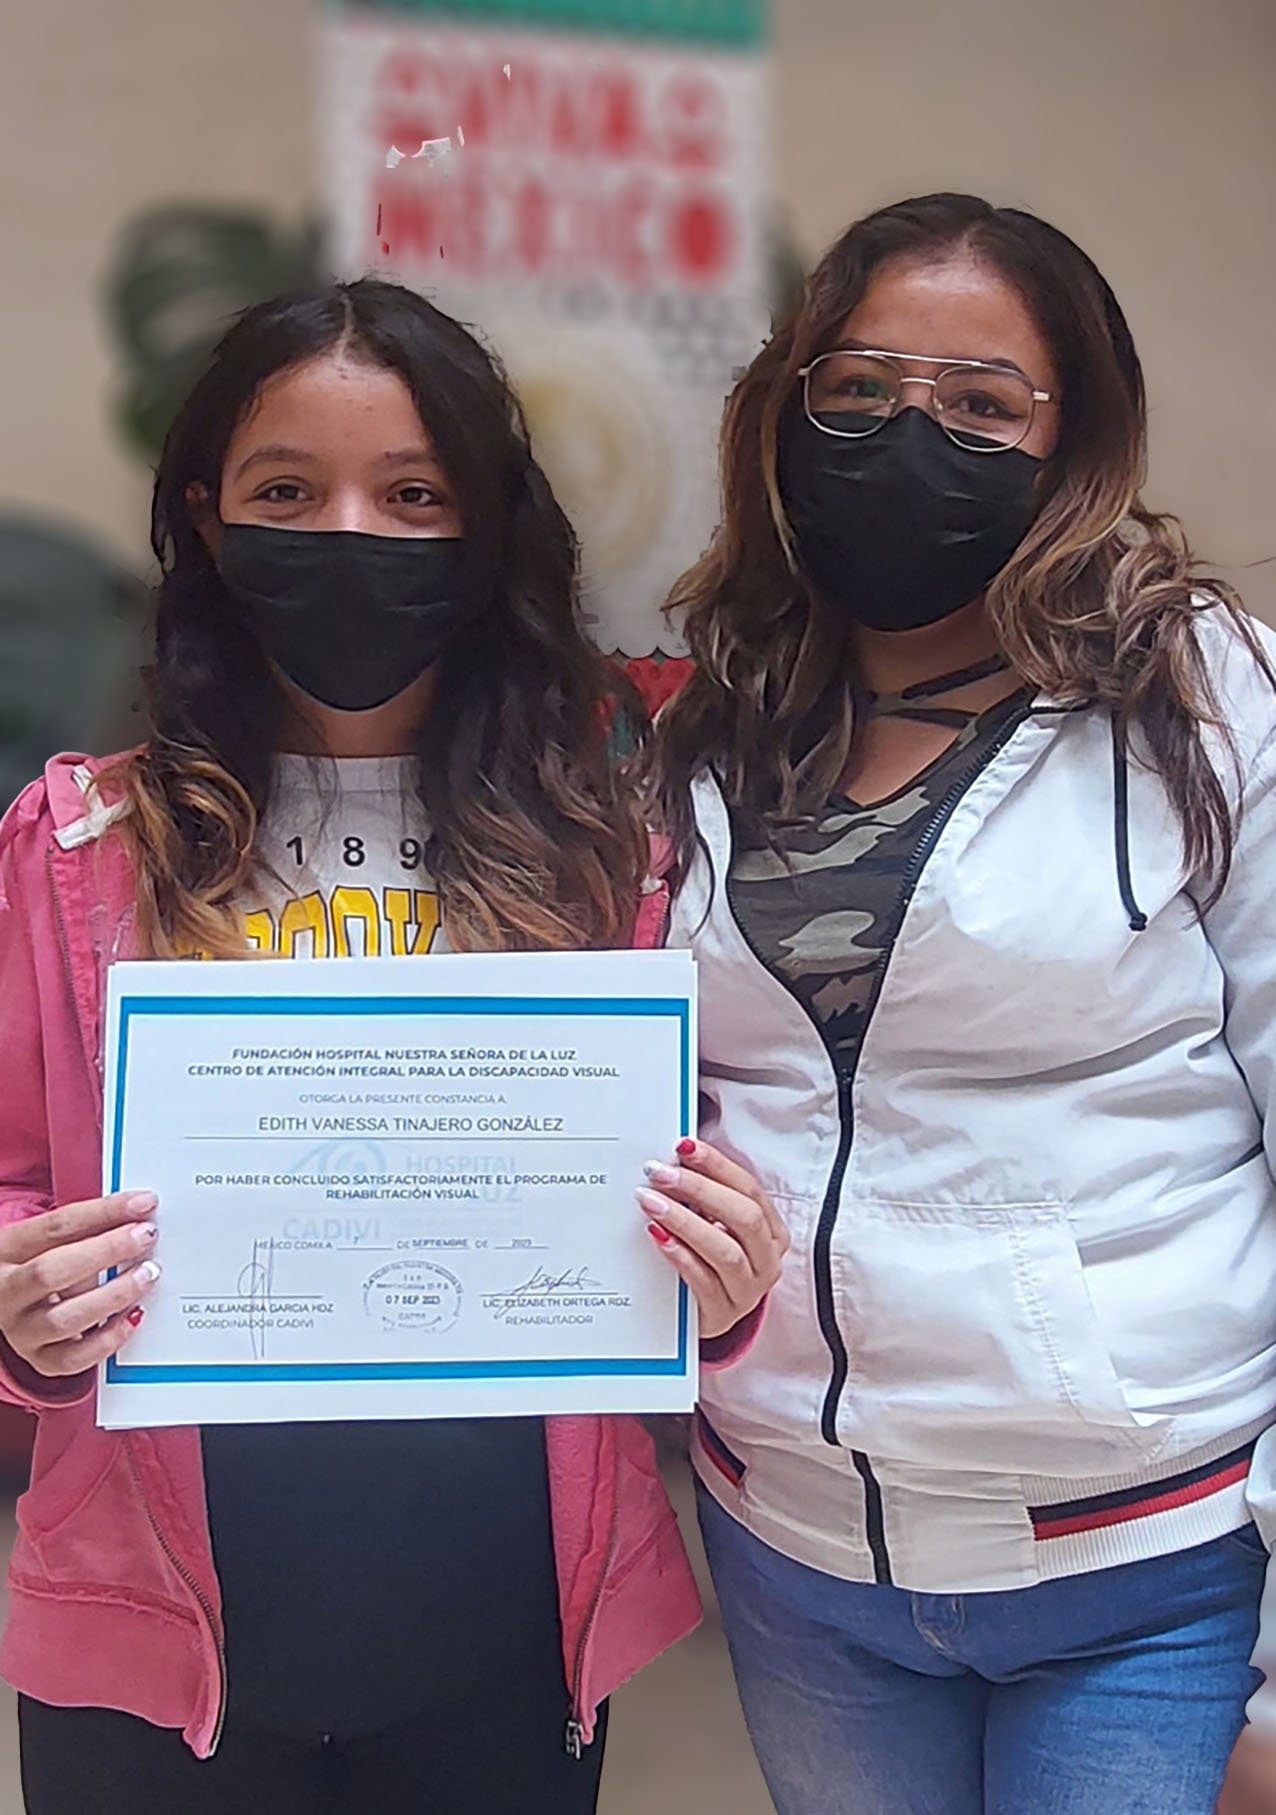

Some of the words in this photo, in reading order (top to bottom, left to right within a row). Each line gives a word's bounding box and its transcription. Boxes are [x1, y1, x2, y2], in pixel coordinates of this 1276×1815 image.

[233, 1048, 312, 1059] FUNDACIÓN
[316, 1050, 381, 1060] HOSPITAL
[385, 1050, 447, 1060] NUESTRA
[451, 1048, 505, 1060] SEÑORA
[509, 1050, 527, 1060] DE
[531, 1051, 547, 1060] LA
[551, 1051, 576, 1060] LUZ
[188, 1066, 242, 1076] CENTRO
[246, 1066, 263, 1075] DE
[267, 1065, 335, 1076] ATENCIÓN
[339, 1066, 405, 1077] INTEGRAL
[409, 1067, 445, 1076] PARA
[448, 1067, 465, 1077] LA
[469, 1067, 569, 1077] DISCAPACIDAD
[572, 1067, 619, 1077] VISUAL
[299, 1094, 346, 1103] OTORGA
[349, 1094, 363, 1103] LA
[365, 1094, 422, 1104] PRESENTE
[424, 1094, 495, 1104] CONSTANCIA
[259, 1117, 307, 1130] EDITH
[312, 1117, 388, 1131] VANESSA
[393, 1118, 472, 1131] TINAJERO
[477, 1116, 563, 1131] GONZÁLEZ
[196, 1175, 223, 1185] POR
[226, 1175, 270, 1185] HABER
[273, 1175, 350, 1185] CONCLUIDO
[353, 1175, 492, 1185] SATISFACTORIAMENTE
[496, 1175, 511, 1185] EL
[514, 1175, 586, 1184] PROGRAMA
[590, 1175, 606, 1184] DE
[326, 1188, 431, 1199] REHABILITACIÓN
[434, 1189, 478, 1199] VISUAL
[282, 1218, 381, 1240] CADIVI
[562, 1297, 605, 1307] ORTEGA
[187, 1318, 274, 1329] COORDINADOR
[276, 1318, 314, 1328] CADIVI
[505, 1314, 593, 1325] REHABILITADOR
